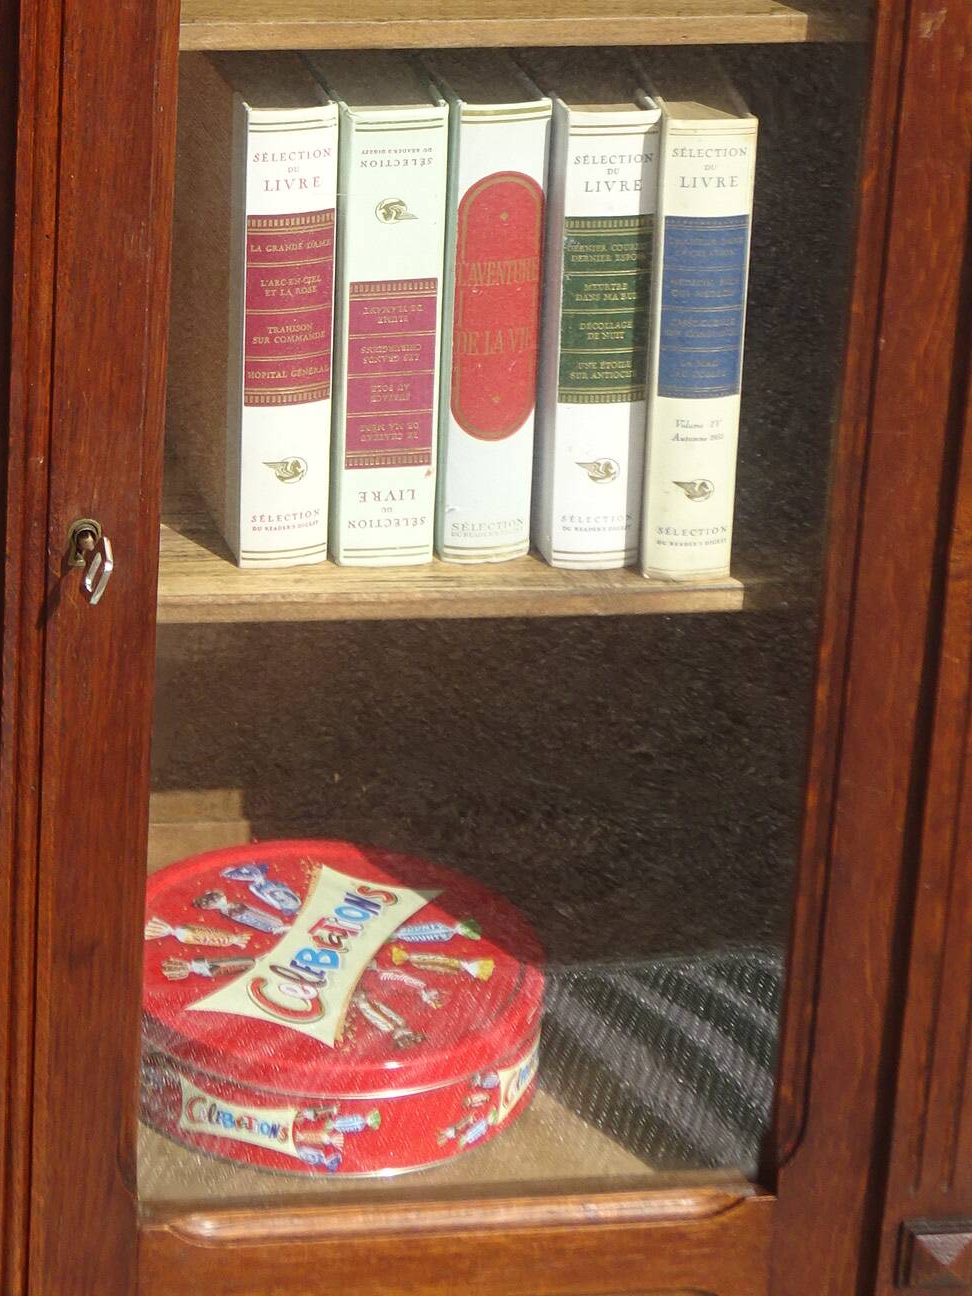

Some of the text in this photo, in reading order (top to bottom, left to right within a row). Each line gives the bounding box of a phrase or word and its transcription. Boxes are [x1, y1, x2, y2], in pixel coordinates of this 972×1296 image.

[253, 148, 332, 163] SÉLECTION
[671, 147, 747, 158] SÉLECTION
[360, 157, 433, 168] SÉLECTION
[574, 153, 654, 165] SÉLECTION
[264, 176, 322, 192] LIVRE
[585, 179, 643, 193] LIVRE
[679, 175, 739, 188] LIVRE
[265, 242, 304, 252] GRANDE
[571, 255, 612, 263] DERNIER
[280, 288, 294, 296] LA
[296, 285, 318, 294] ROSE
[575, 294, 600, 302] DANS
[268, 324, 314, 334] TRAHISON
[251, 331, 326, 344] SUR COMMANDE
[601, 332, 625, 340] NUIT
[484, 329, 504, 355] LA
[570, 372, 588, 380] SUR
[356, 489, 416, 503] LIVRE
[348, 516, 426, 529] SÉLECTION
